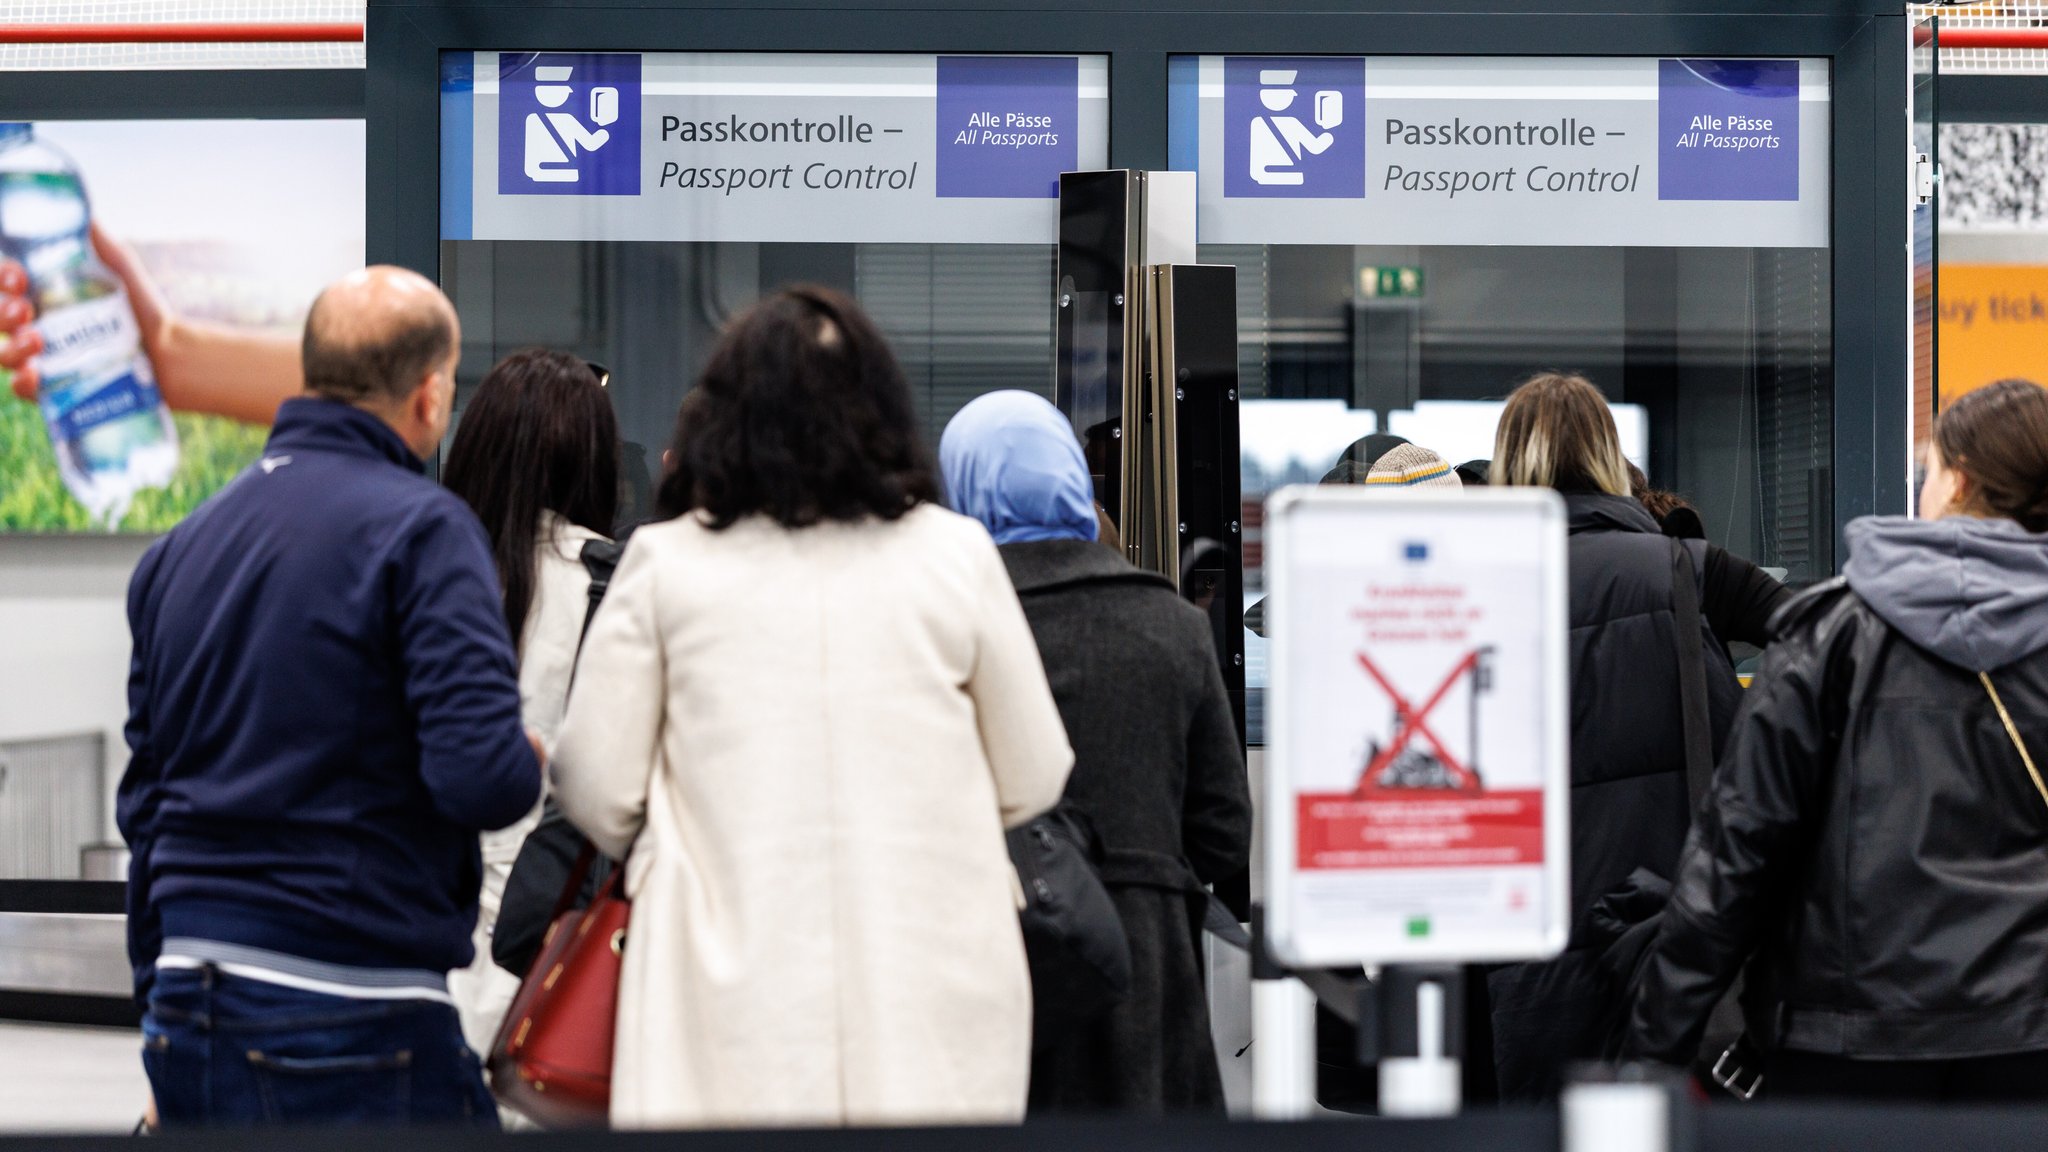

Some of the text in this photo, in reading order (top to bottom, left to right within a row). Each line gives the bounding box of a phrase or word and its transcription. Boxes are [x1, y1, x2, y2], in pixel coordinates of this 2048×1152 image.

[662, 114, 873, 144] Passkontrolle
[967, 111, 1052, 128] Alle Pässe
[1386, 117, 1595, 146] Passkontrolle
[1689, 114, 1774, 131] Alle Pässe
[954, 130, 1059, 150] All Passports
[1675, 132, 1781, 153] All Passports
[659, 161, 918, 197] Passport Control
[1384, 164, 1640, 199] Passport Control
[1938, 292, 2048, 328] uy tick
